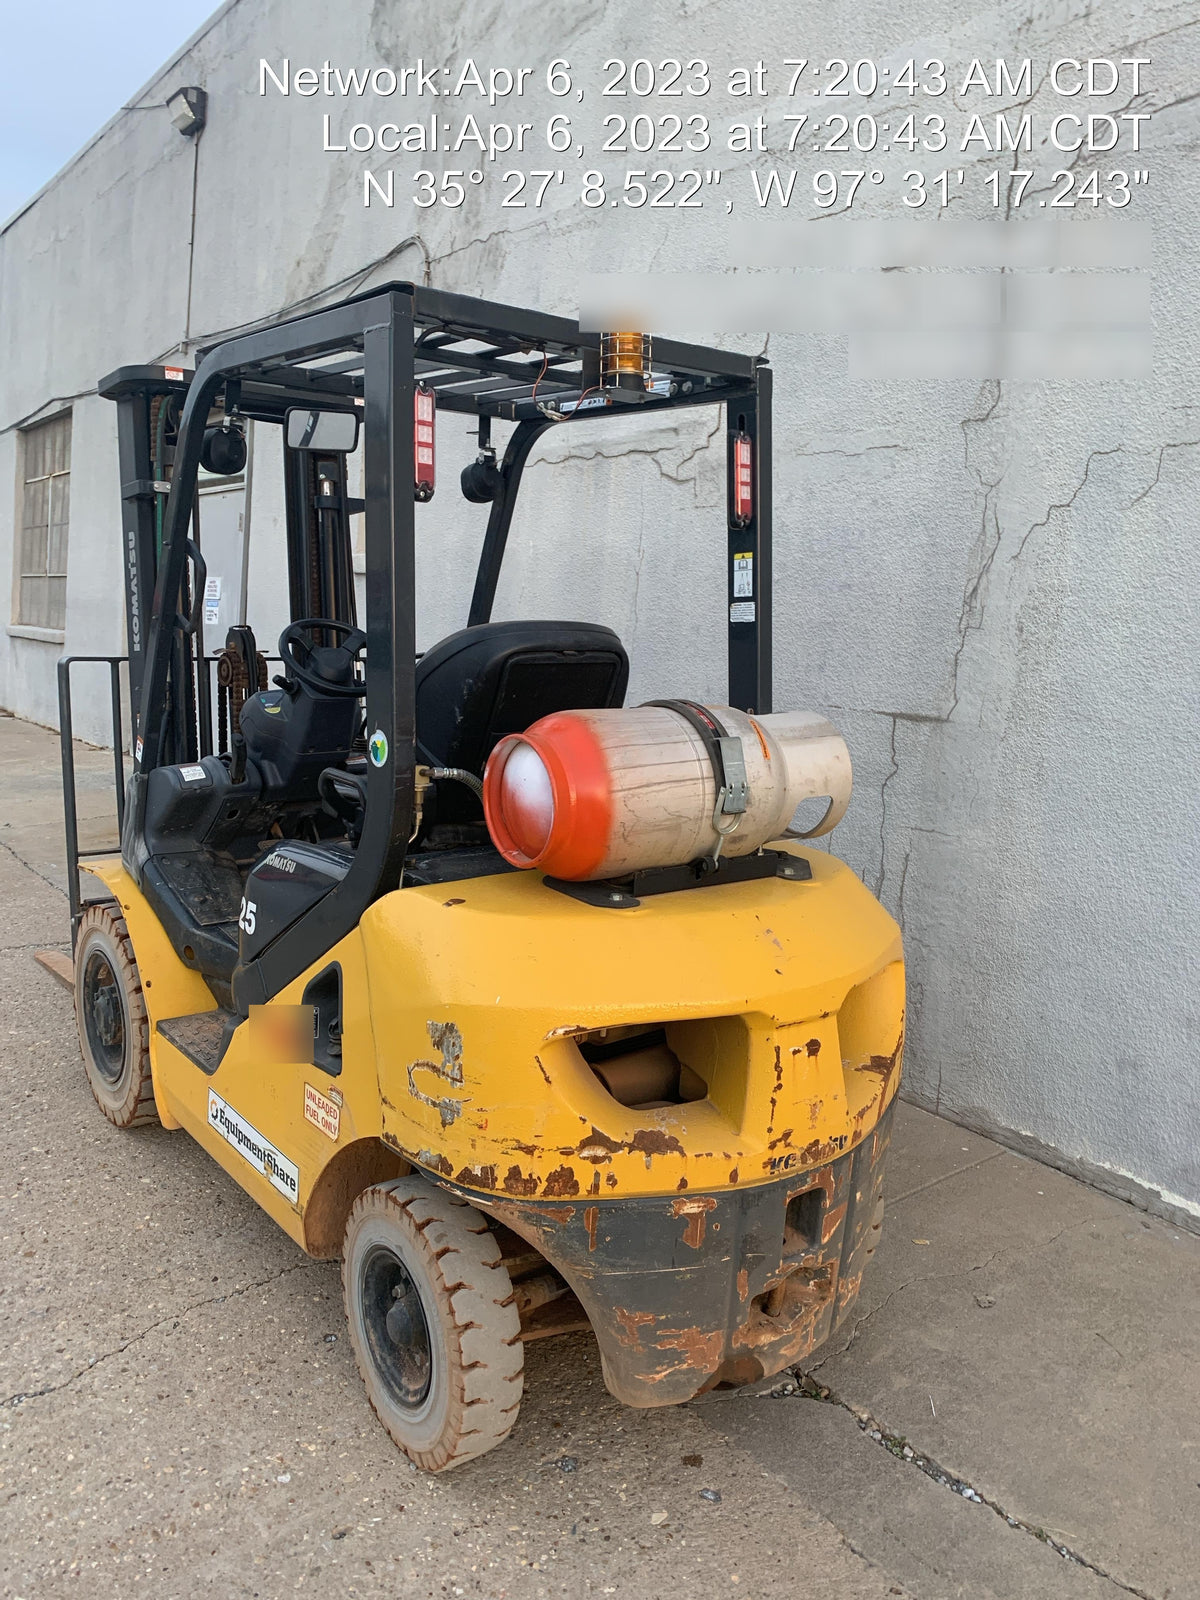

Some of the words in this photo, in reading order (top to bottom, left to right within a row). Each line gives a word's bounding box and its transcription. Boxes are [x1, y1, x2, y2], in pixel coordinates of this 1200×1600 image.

[128, 531, 141, 652] KOMATSU
[265, 854, 297, 874] KOMATSU
[238, 896, 257, 935] 25
[305, 1104, 321, 1124] FUEL
[321, 1116, 338, 1136] ONLY
[306, 1088, 338, 1120] UNLEADED
[219, 1108, 297, 1192] EquipmentShare
